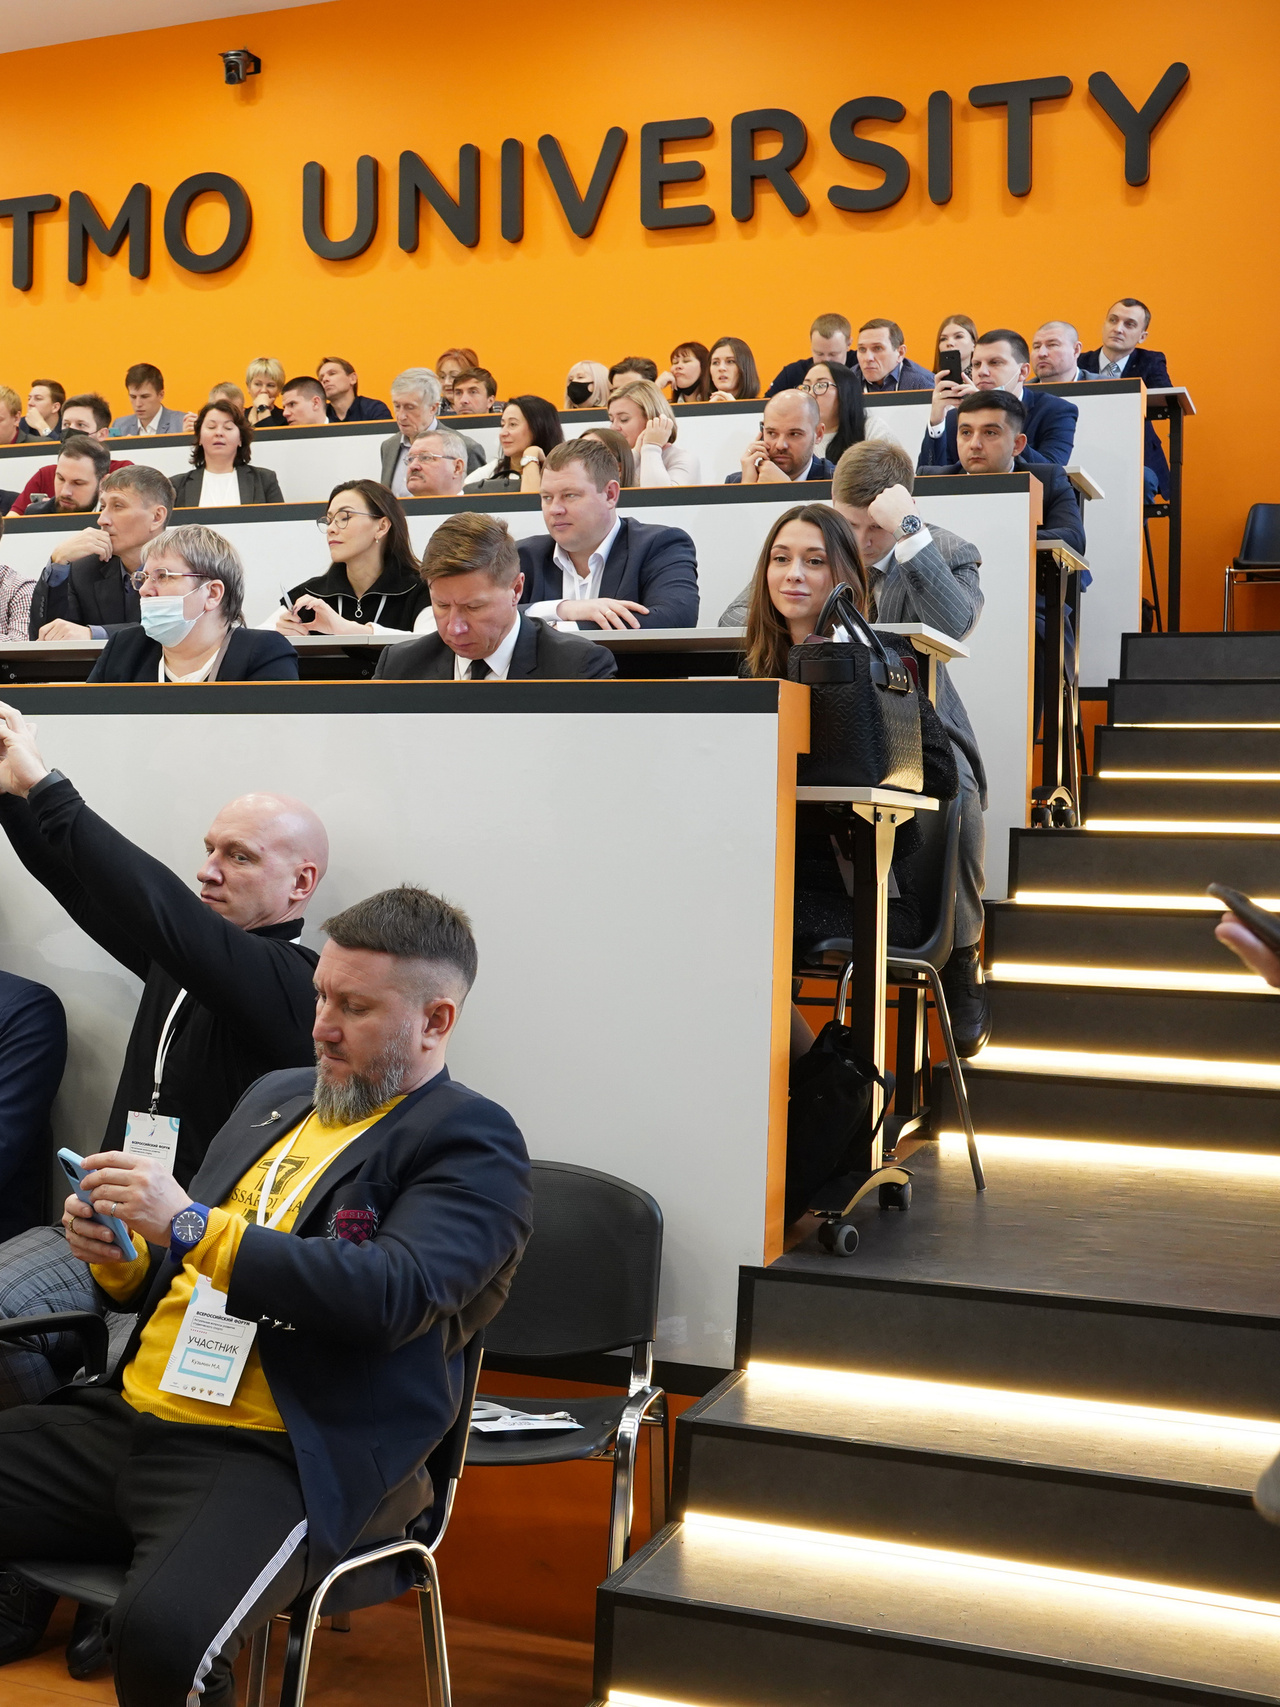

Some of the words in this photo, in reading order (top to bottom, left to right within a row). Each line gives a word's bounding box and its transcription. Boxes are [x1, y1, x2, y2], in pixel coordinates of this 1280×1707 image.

[303, 62, 1190, 261] UNIVERSITY
[196, 1311, 233, 1322] ВСЕРОССИЙСКИЙ
[187, 1335, 240, 1355] УЧАСТНИК
